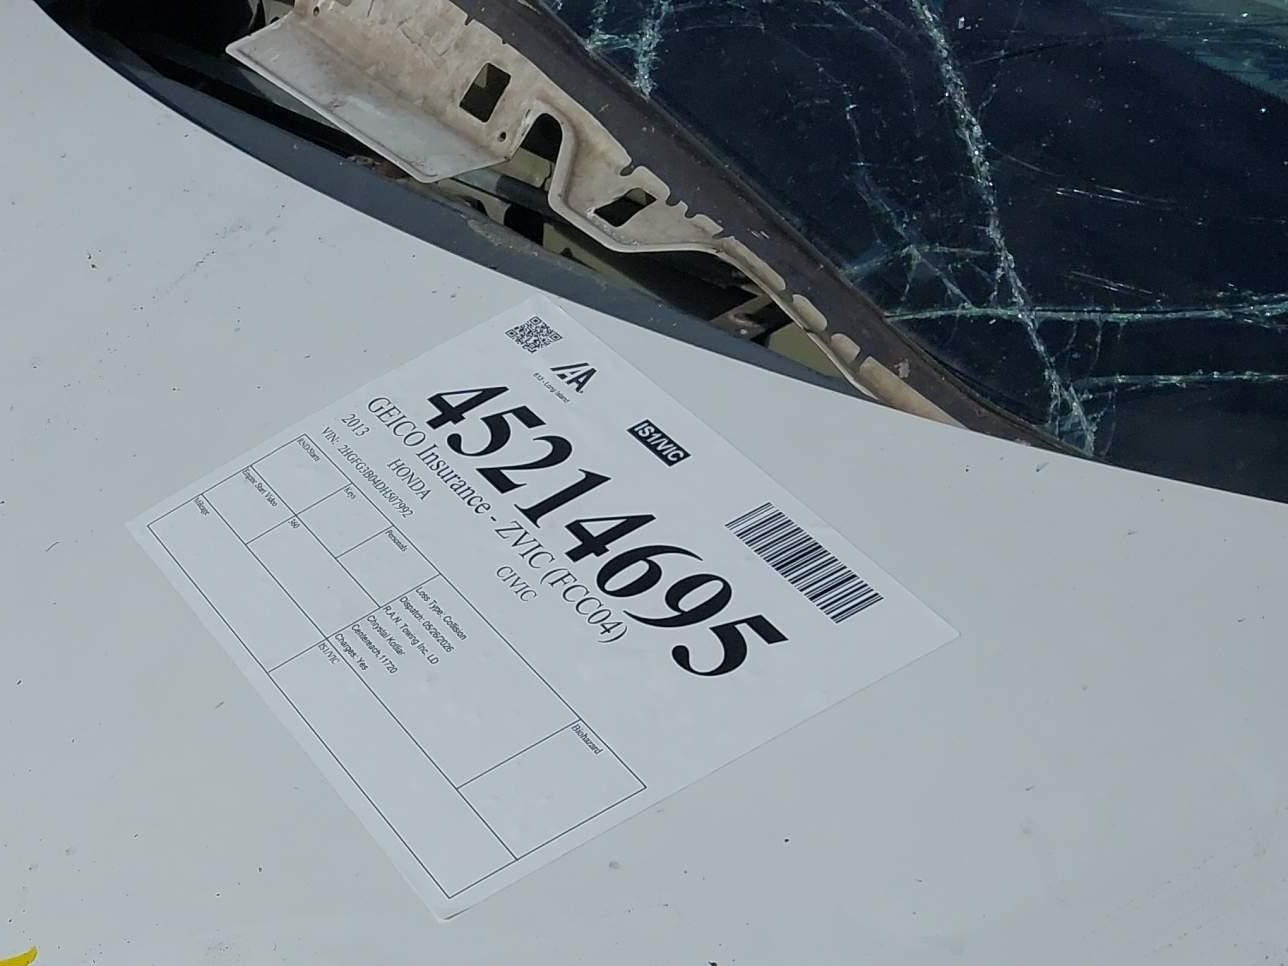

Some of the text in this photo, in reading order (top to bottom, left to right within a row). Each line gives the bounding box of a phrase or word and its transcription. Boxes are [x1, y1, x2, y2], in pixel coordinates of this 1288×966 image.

[321, 426, 342, 445] VIN:
[635, 423, 683, 460] IS1/VIC
[341, 413, 538, 604] 2013 HONDA CIVIC
[364, 394, 429, 449] GEICO
[414, 443, 496, 517] Insurance
[494, 520, 556, 569] ZVIC
[537, 568, 631, 648] (FCC04)
[426, 386, 789, 676] 45214695
[416, 587, 430, 601] Loss
[443, 616, 467, 640] Collision
[356, 657, 368, 670] Yes
[400, 623, 420, 646] Towing
[426, 654, 439, 664] LD
[571, 724, 603, 755] Biohazard
